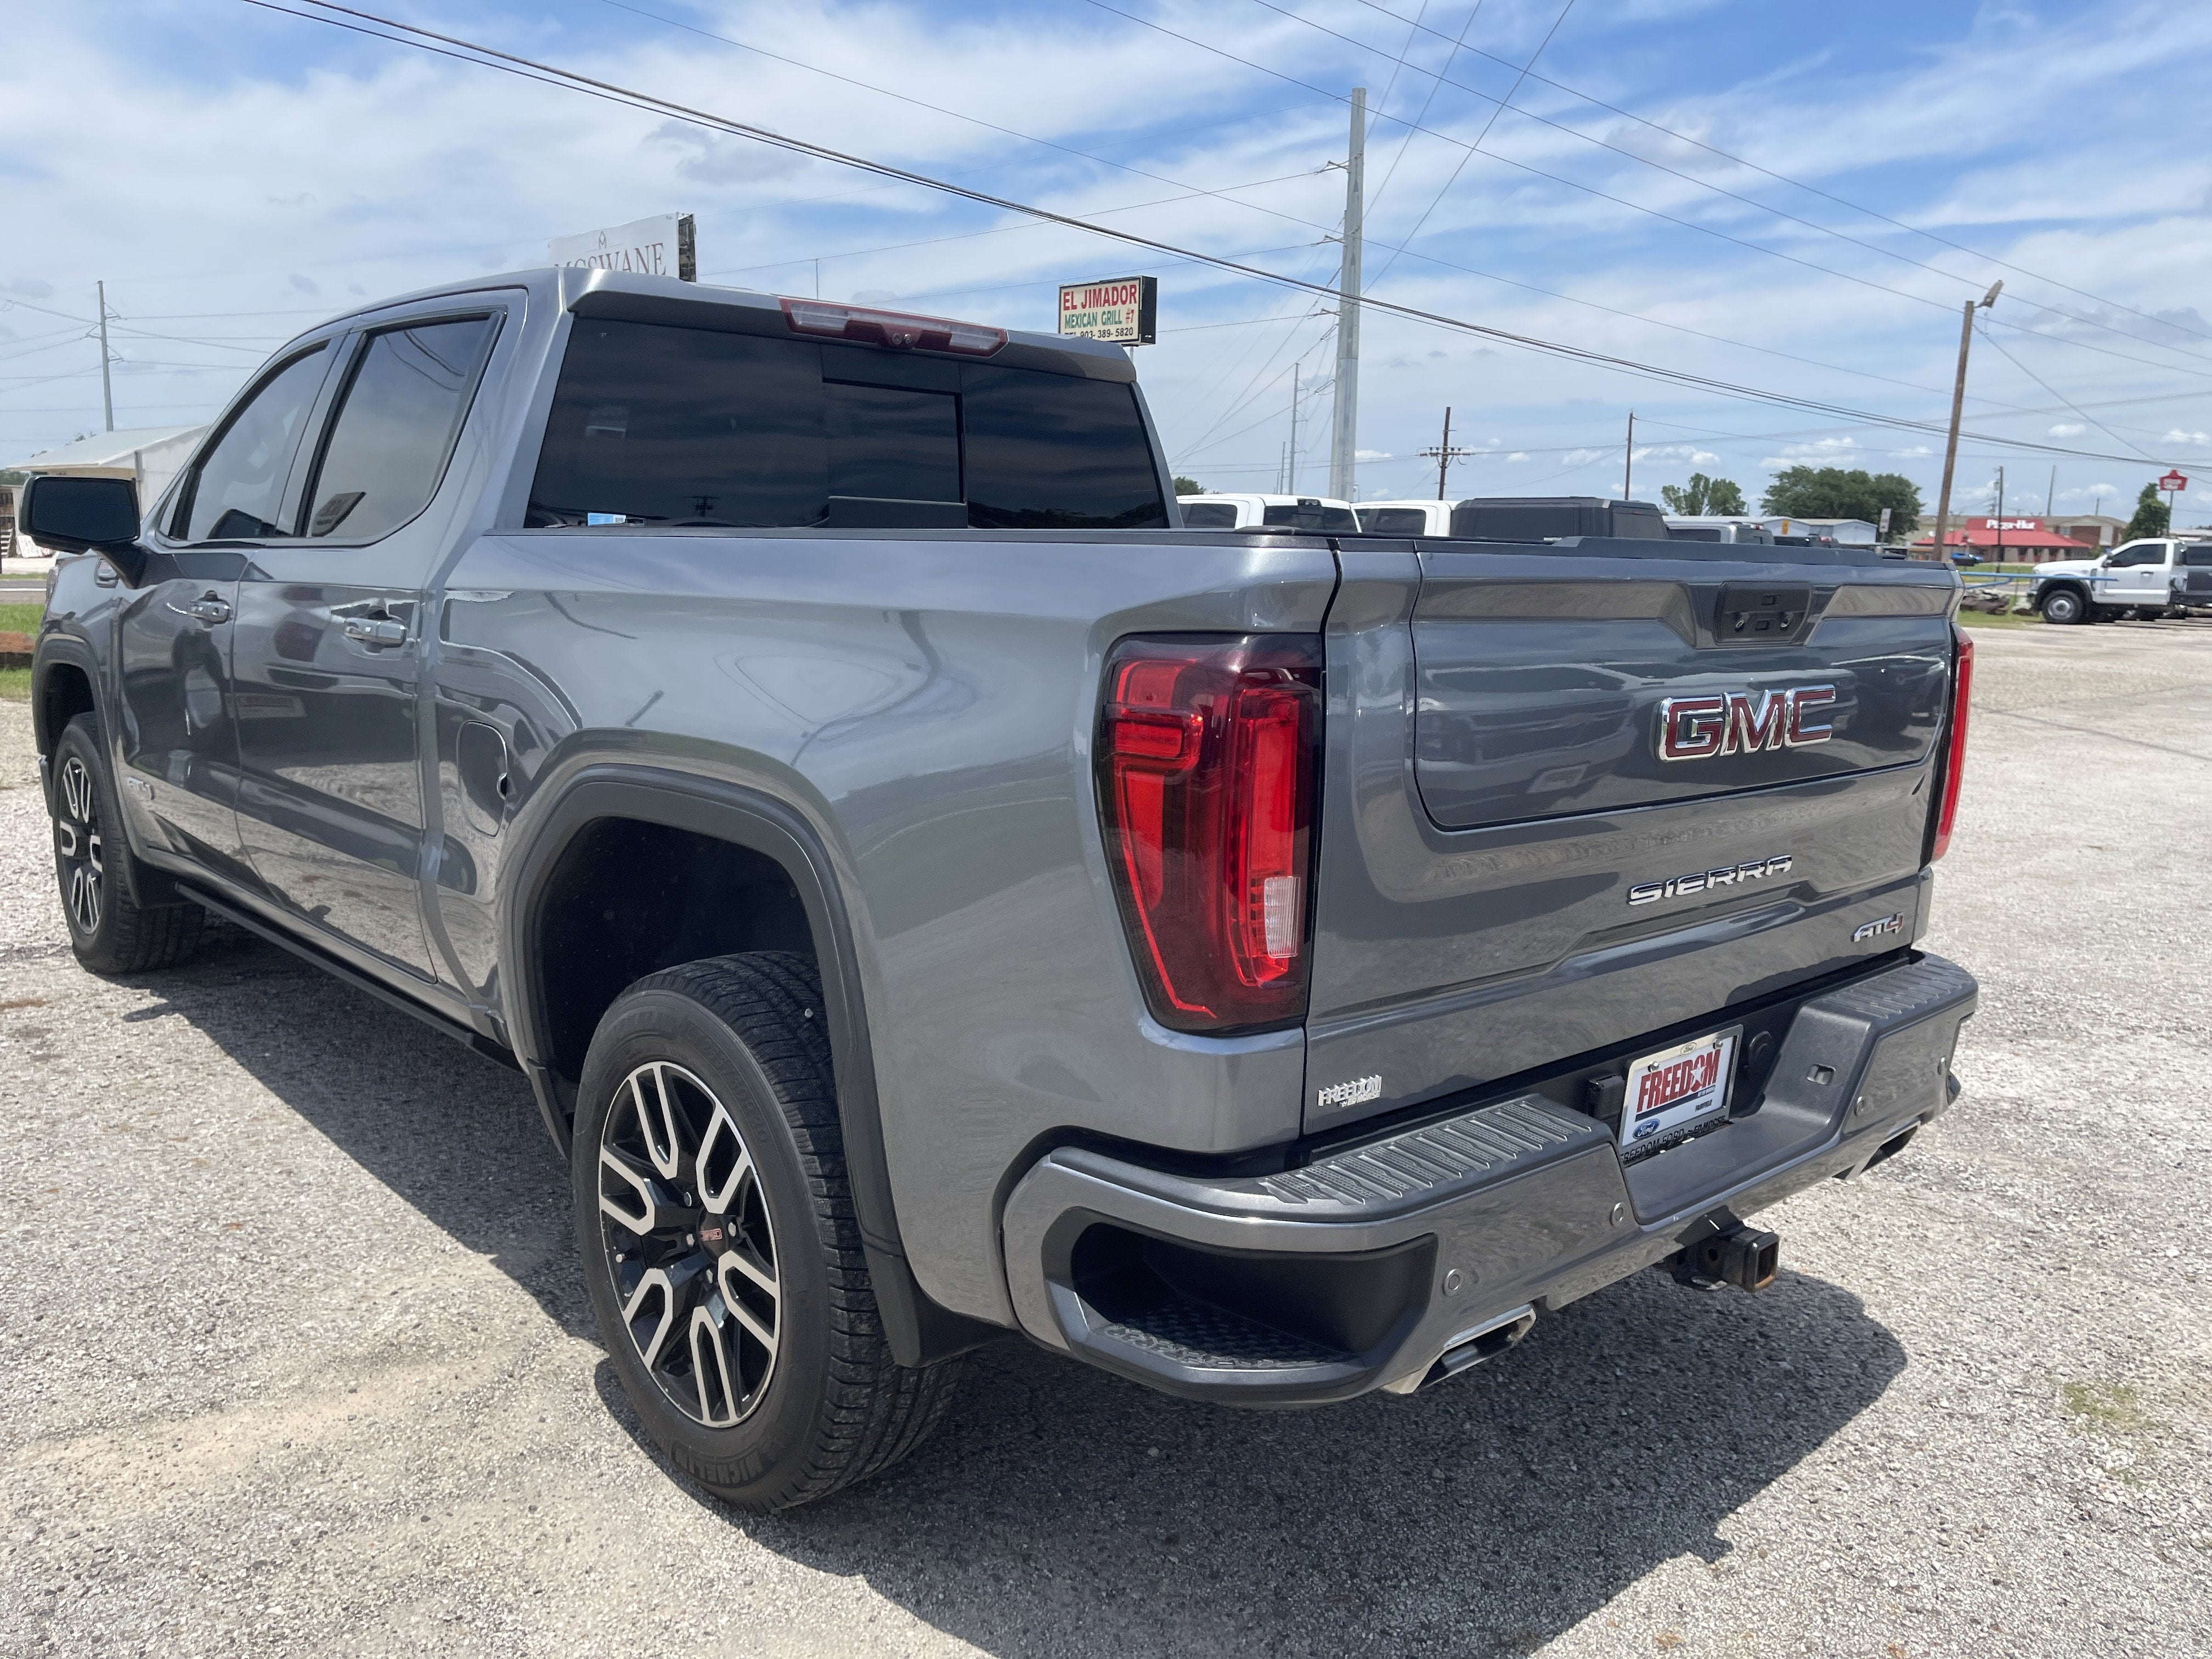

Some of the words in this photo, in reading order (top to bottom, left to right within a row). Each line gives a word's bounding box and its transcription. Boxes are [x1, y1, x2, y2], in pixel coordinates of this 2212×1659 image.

[554, 242, 666, 275] SWANE
[1063, 291, 1077, 311] EL
[1081, 284, 1137, 309] JIMADOR
[1065, 312, 1097, 329] MEXICAN
[1101, 309, 1122, 325] GRILL
[1115, 327, 1133, 337] 5820
[1658, 684, 1836, 761] GMC
[1627, 854, 1792, 906] SIERRA
[1851, 911, 1904, 943] AT4
[1318, 1074, 1383, 1107] FREEDOM
[1637, 1048, 1721, 1113] FREEDOM
[1638, 1122, 1655, 1137] Ford
